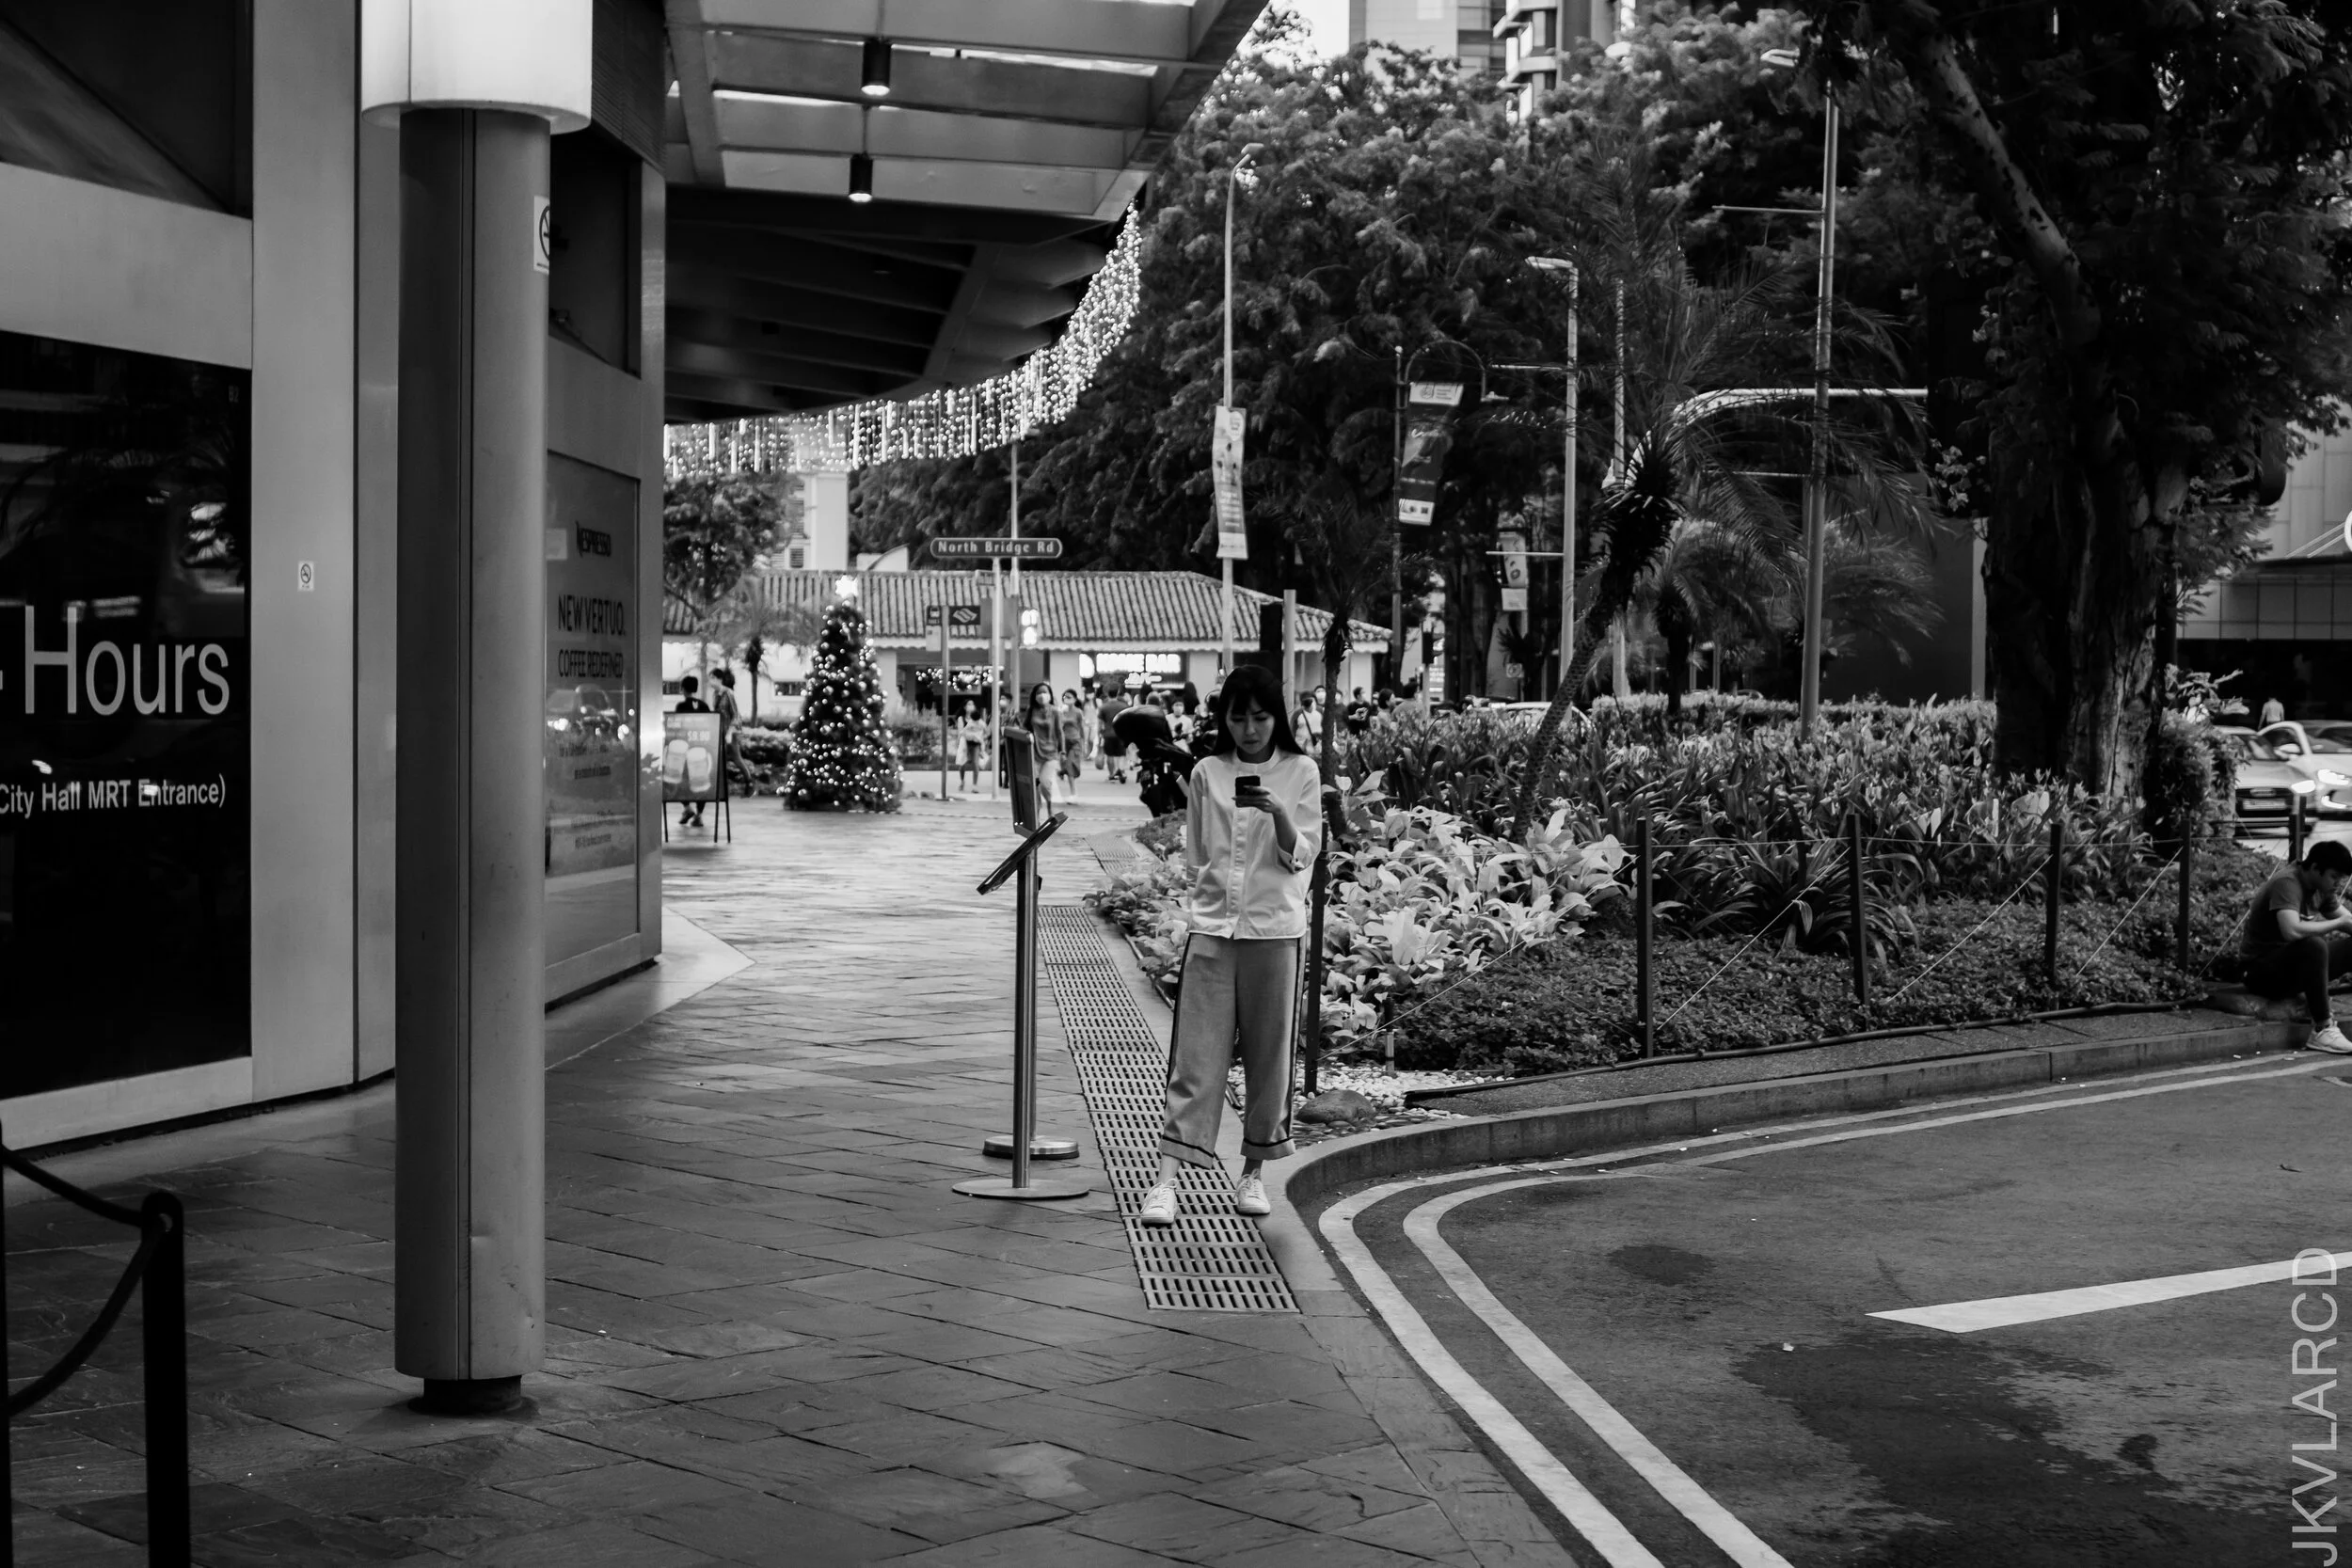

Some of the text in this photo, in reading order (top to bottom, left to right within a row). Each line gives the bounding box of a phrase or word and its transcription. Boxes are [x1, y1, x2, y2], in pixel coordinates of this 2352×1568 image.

[938, 541, 1055, 556] North Bridge Rd
[558, 594, 583, 632] NEW
[558, 649, 624, 678] COFFEE REDEFINED
[41, 781, 81, 811] Hall
[88, 780, 131, 809] MRT
[138, 774, 226, 808] Entrance)
